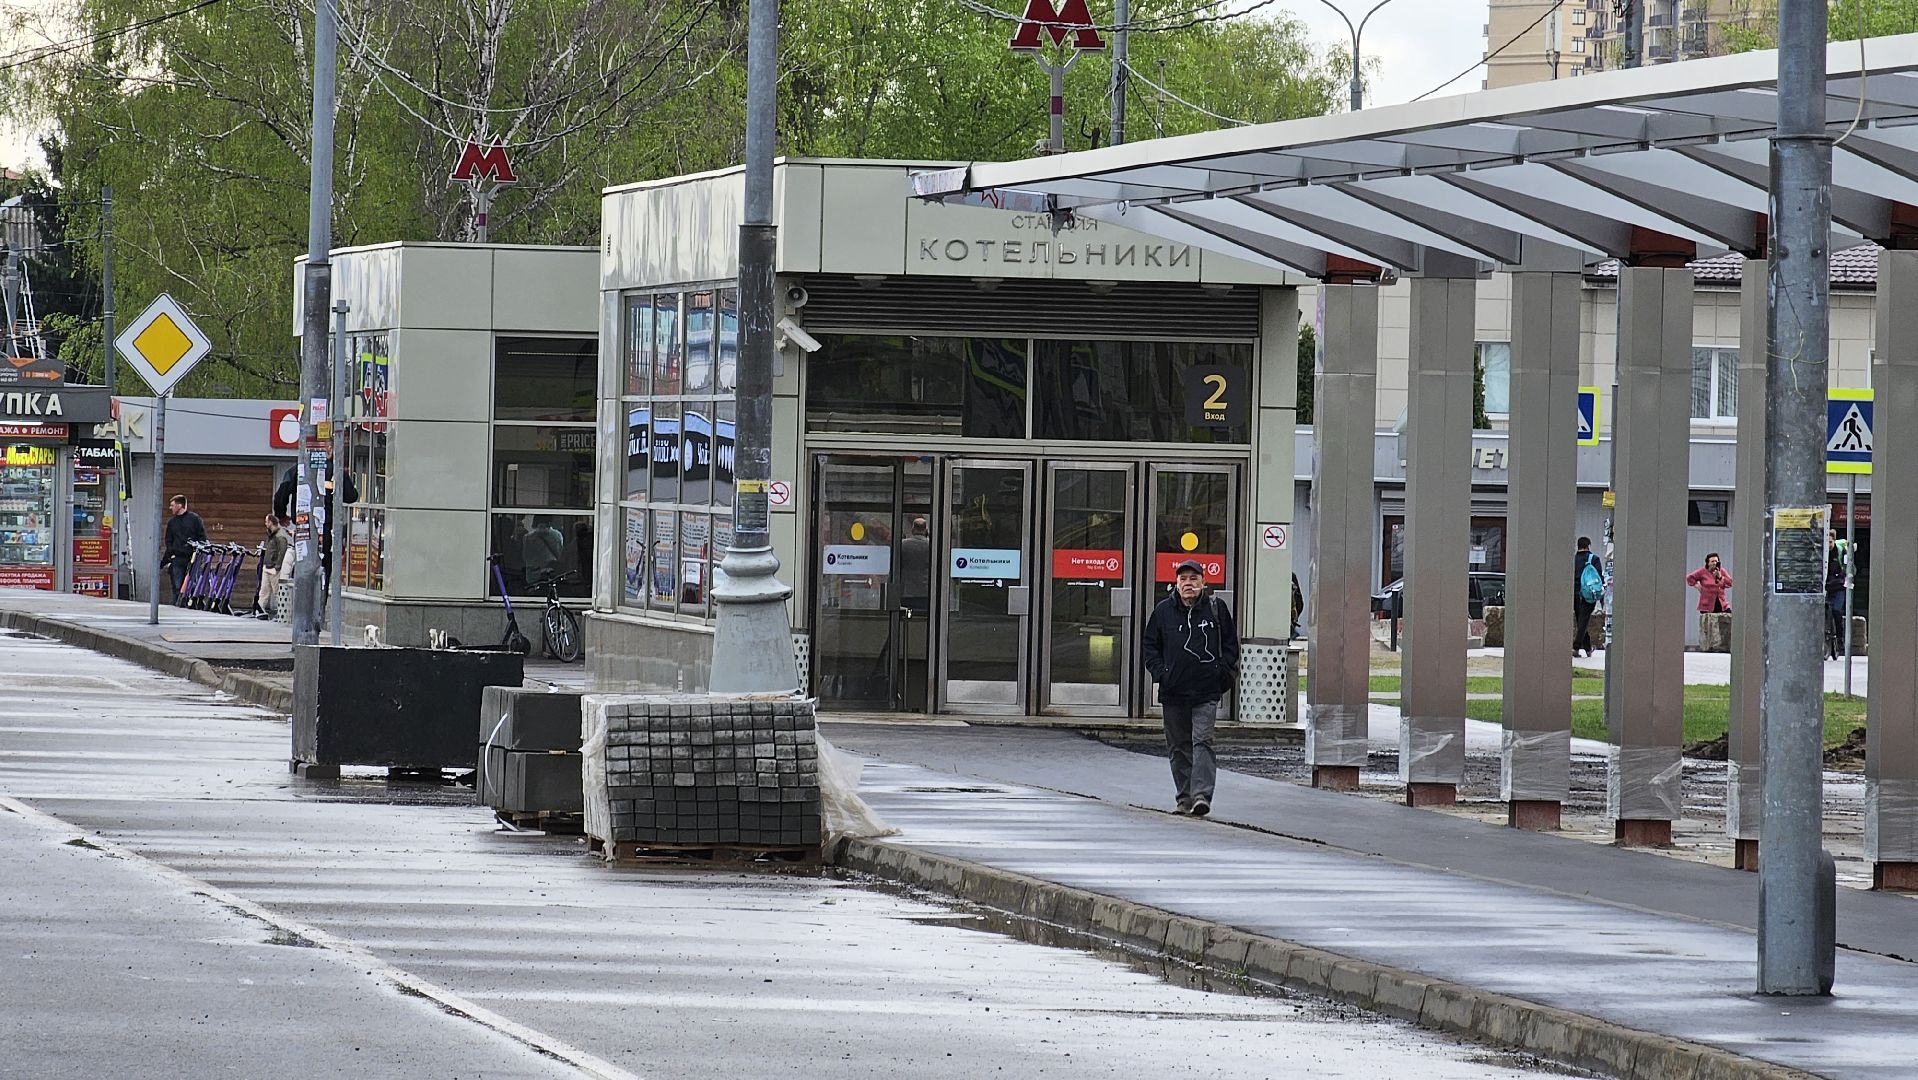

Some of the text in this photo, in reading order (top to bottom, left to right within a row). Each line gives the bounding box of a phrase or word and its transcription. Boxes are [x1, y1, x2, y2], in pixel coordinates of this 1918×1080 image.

[919, 239, 1191, 268] КОТЕЛЬНИКИ
[1203, 374, 1228, 410] 2
[1204, 411, 1226, 421] Вход
[31, 427, 64, 435] РЕМОНТ
[567, 433, 596, 448] PRICE
[80, 447, 115, 458] ТАБАК
